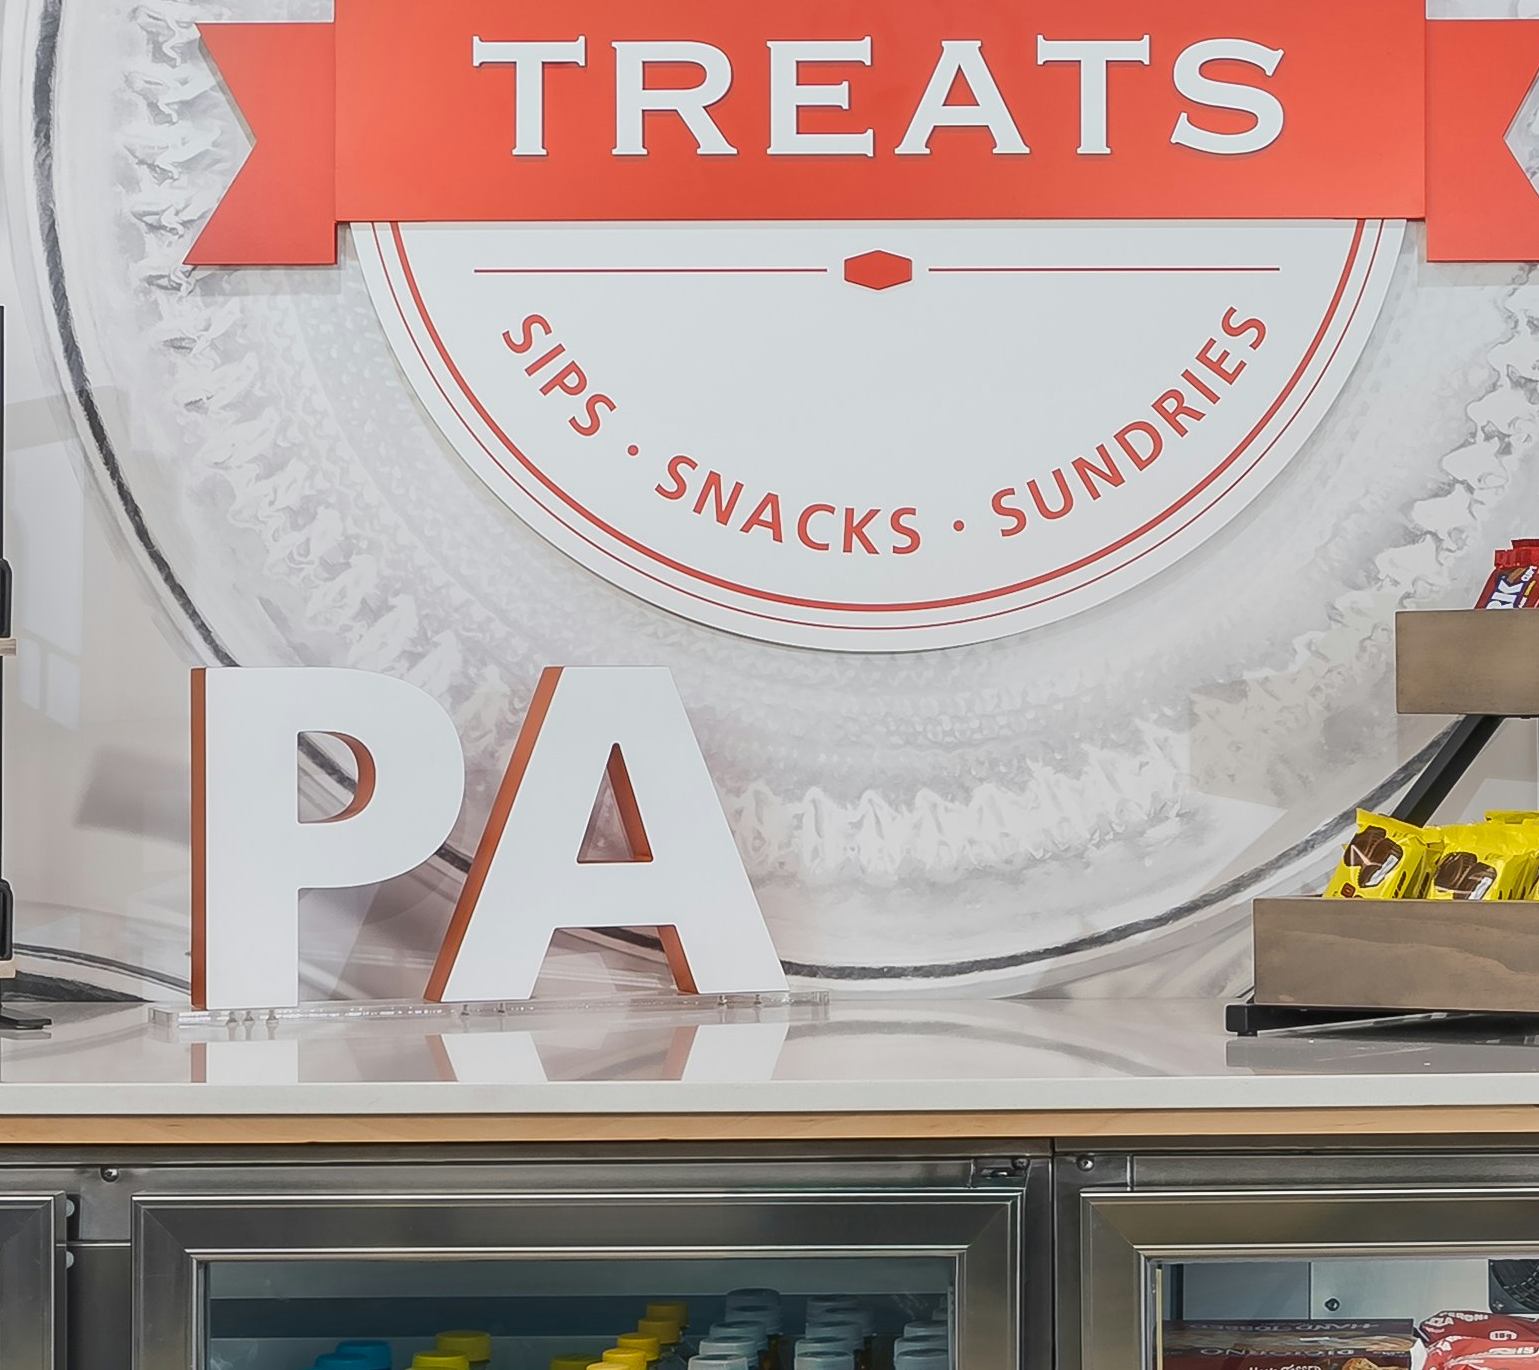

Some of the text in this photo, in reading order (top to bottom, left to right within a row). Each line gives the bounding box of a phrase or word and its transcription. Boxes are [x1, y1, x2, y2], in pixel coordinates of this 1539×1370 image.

[472, 34, 1285, 158] TREATS
[501, 306, 1268, 555] SIPS SNACKS SUNDRIES
[190, 665, 789, 1011] PA
